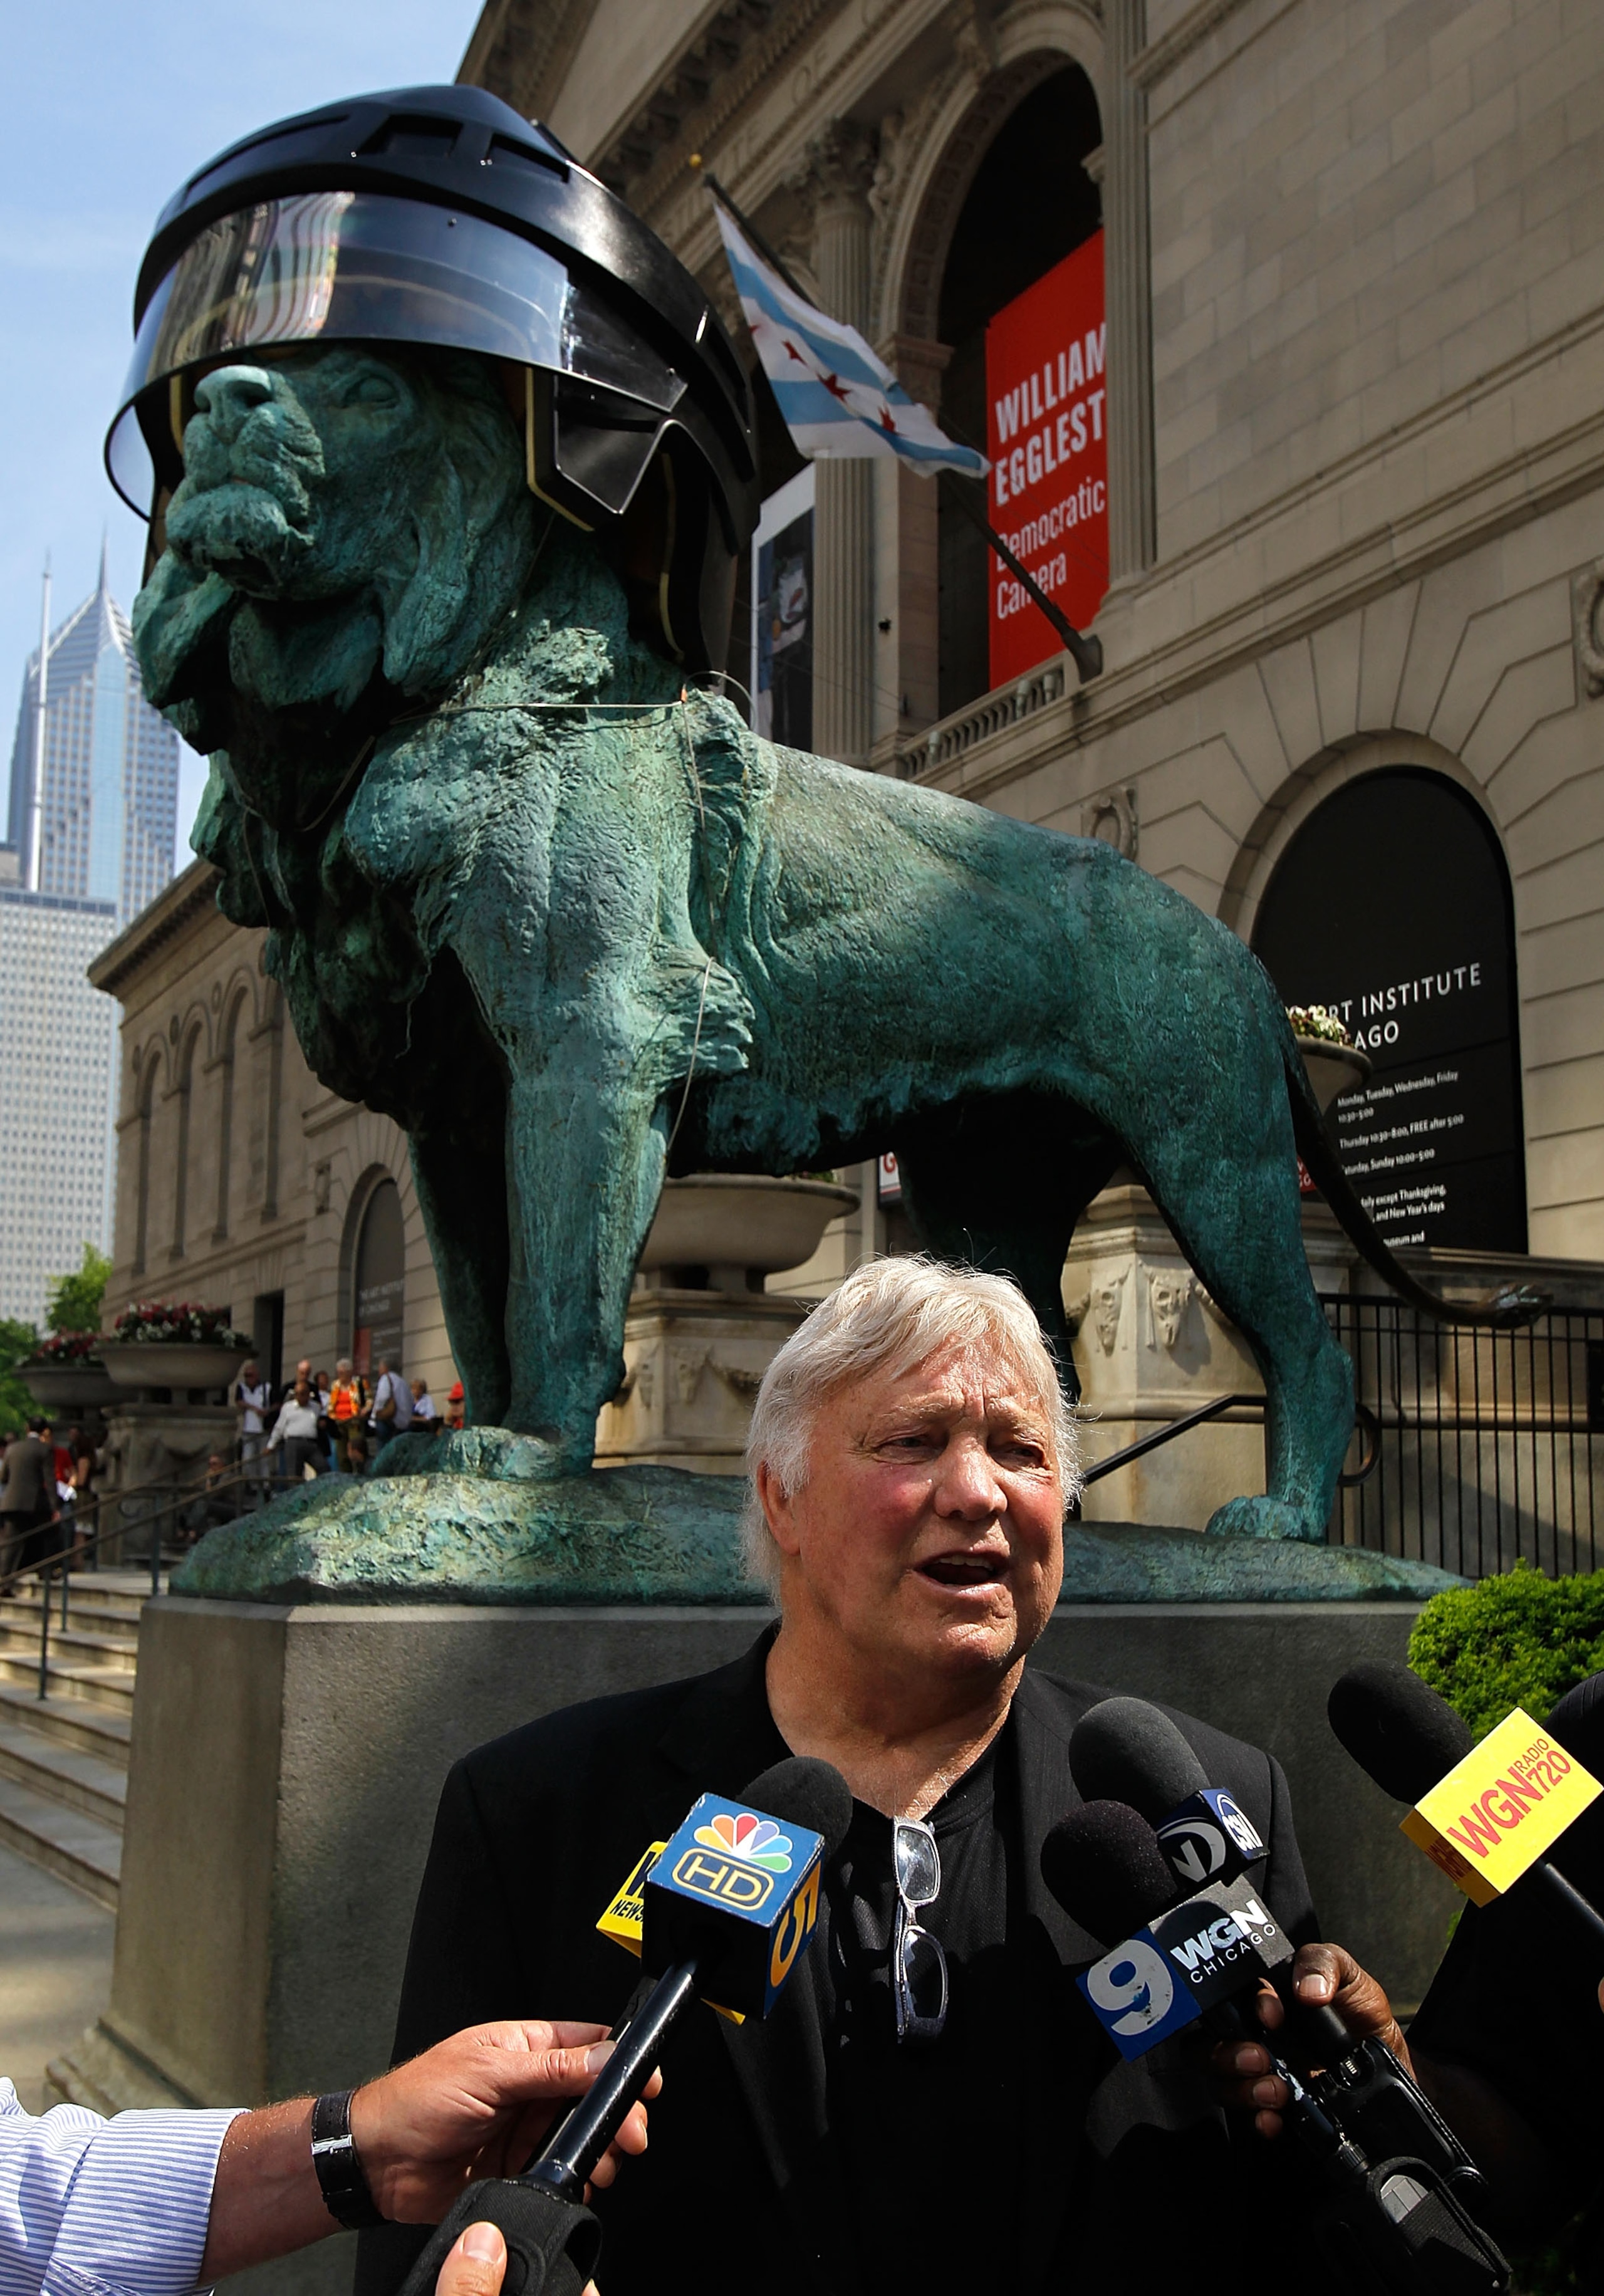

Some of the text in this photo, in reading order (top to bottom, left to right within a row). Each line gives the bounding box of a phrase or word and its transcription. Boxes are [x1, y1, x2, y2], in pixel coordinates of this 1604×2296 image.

[995, 322, 1106, 443] WILLIAM
[996, 389, 1105, 506] EGGLEST
[1362, 963, 1481, 1018] INSTITUTE
[1365, 1086, 1394, 1101] Tuesday,
[1437, 1070, 1459, 1083] Friday
[1340, 1135, 1369, 1150] Thursday
[1410, 1119, 1429, 1134] FREE
[1429, 1117, 1447, 1130] after
[1370, 1156, 1395, 1170] Sunday
[1375, 1192, 1398, 1206] except
[1376, 1209, 1389, 1222] and
[1390, 1207, 1405, 1219] New
[1428, 1200, 1445, 1214] days
[1411, 1229, 1425, 1243] and
[1513, 1738, 1549, 1773] RADIO
[1446, 1766, 1544, 1859] WGN
[1526, 1750, 1571, 1793] 720
[684, 1855, 763, 1902] HD
[770, 1860, 821, 1988] 5
[1170, 1899, 1269, 1970] WGN
[1190, 1924, 1276, 1984] CHICAGO
[1087, 1939, 1174, 2036] 9
